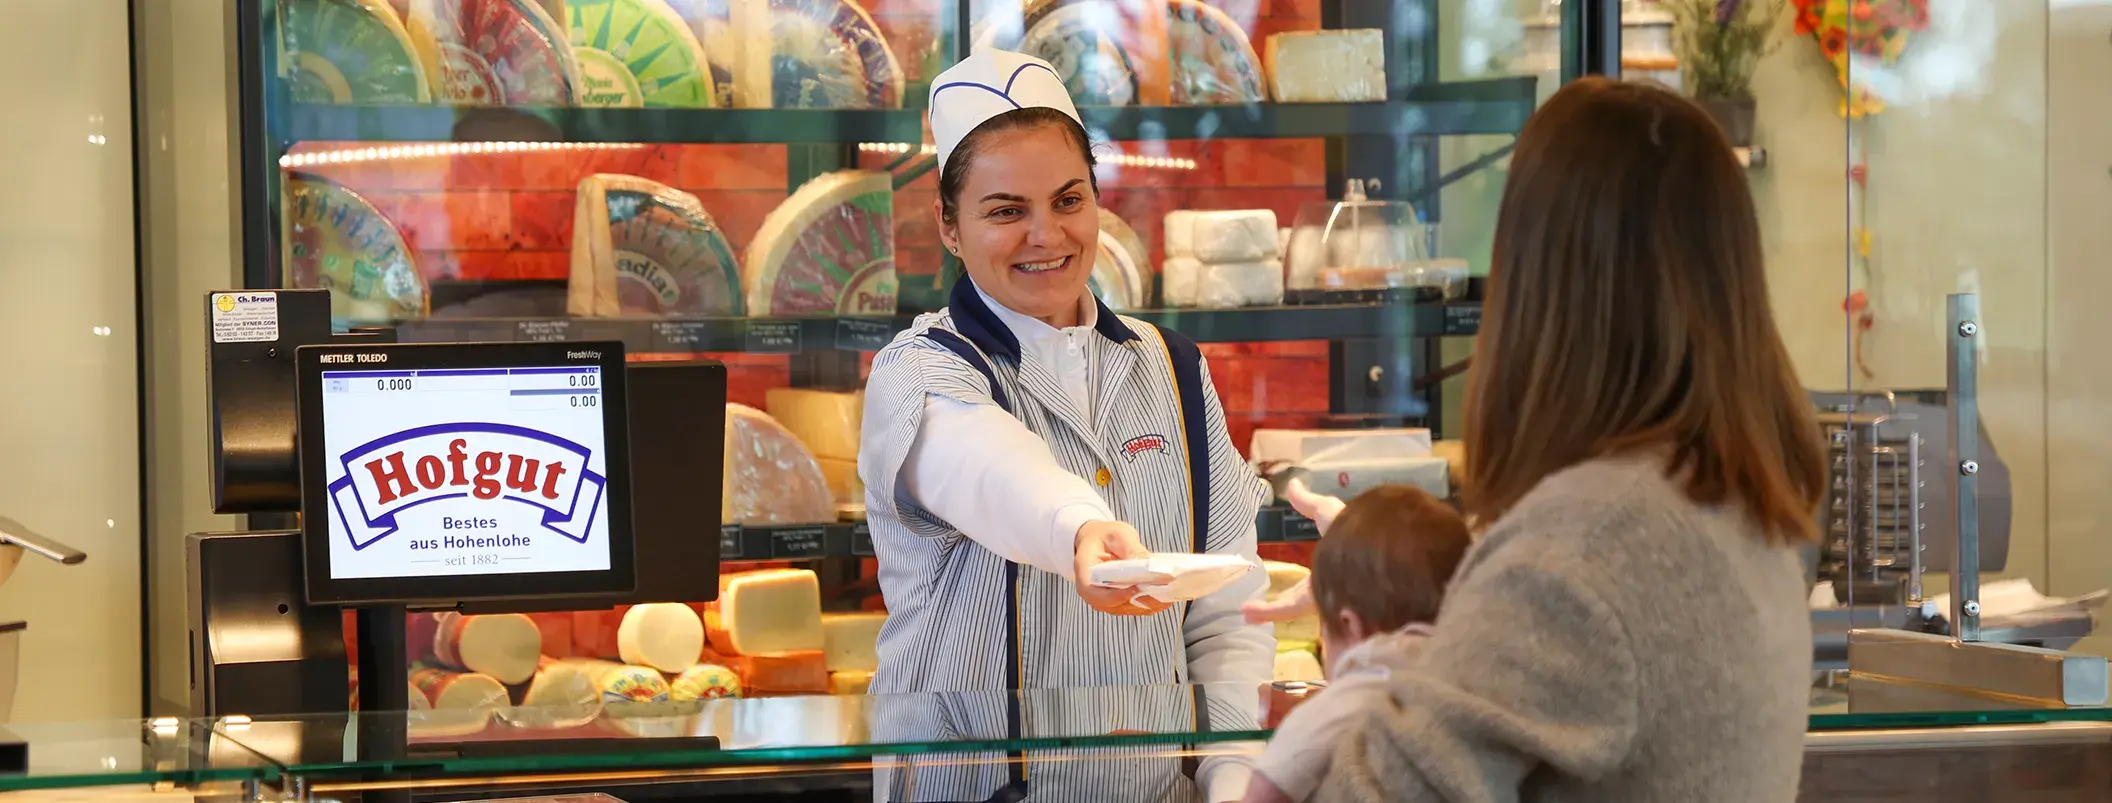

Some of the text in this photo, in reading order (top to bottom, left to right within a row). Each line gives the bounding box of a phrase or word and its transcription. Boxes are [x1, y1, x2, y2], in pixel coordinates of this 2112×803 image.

[320, 353, 388, 364] METTLER TOLEDO
[567, 350, 601, 360] FreshWay
[377, 378, 412, 391] 0.000
[569, 374, 596, 387] 0.00
[570, 395, 597, 408] 0.00
[1126, 438, 1161, 453] Hofgut
[364, 438, 566, 505] Hofgut
[443, 516, 498, 530] Bestes
[410, 534, 531, 550] aus Hohenlohe
[444, 553, 499, 566] seit 1882
